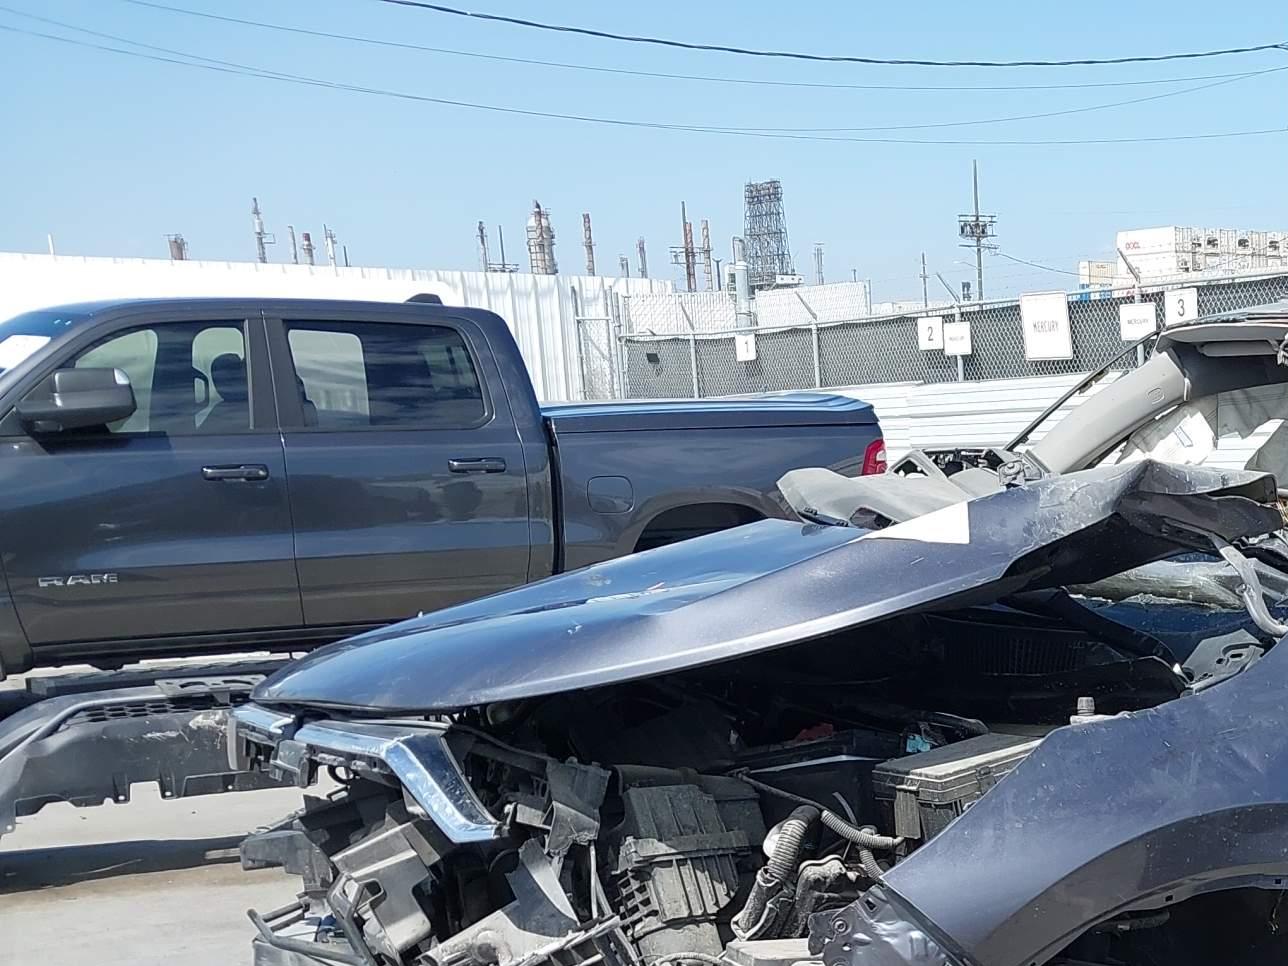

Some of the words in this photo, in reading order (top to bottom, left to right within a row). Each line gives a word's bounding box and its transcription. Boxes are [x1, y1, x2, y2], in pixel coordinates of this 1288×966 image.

[1177, 298, 1185, 317] 3
[927, 326, 934, 342] 2
[1033, 320, 1059, 334] MERCURY
[38, 573, 118, 587] RAM
